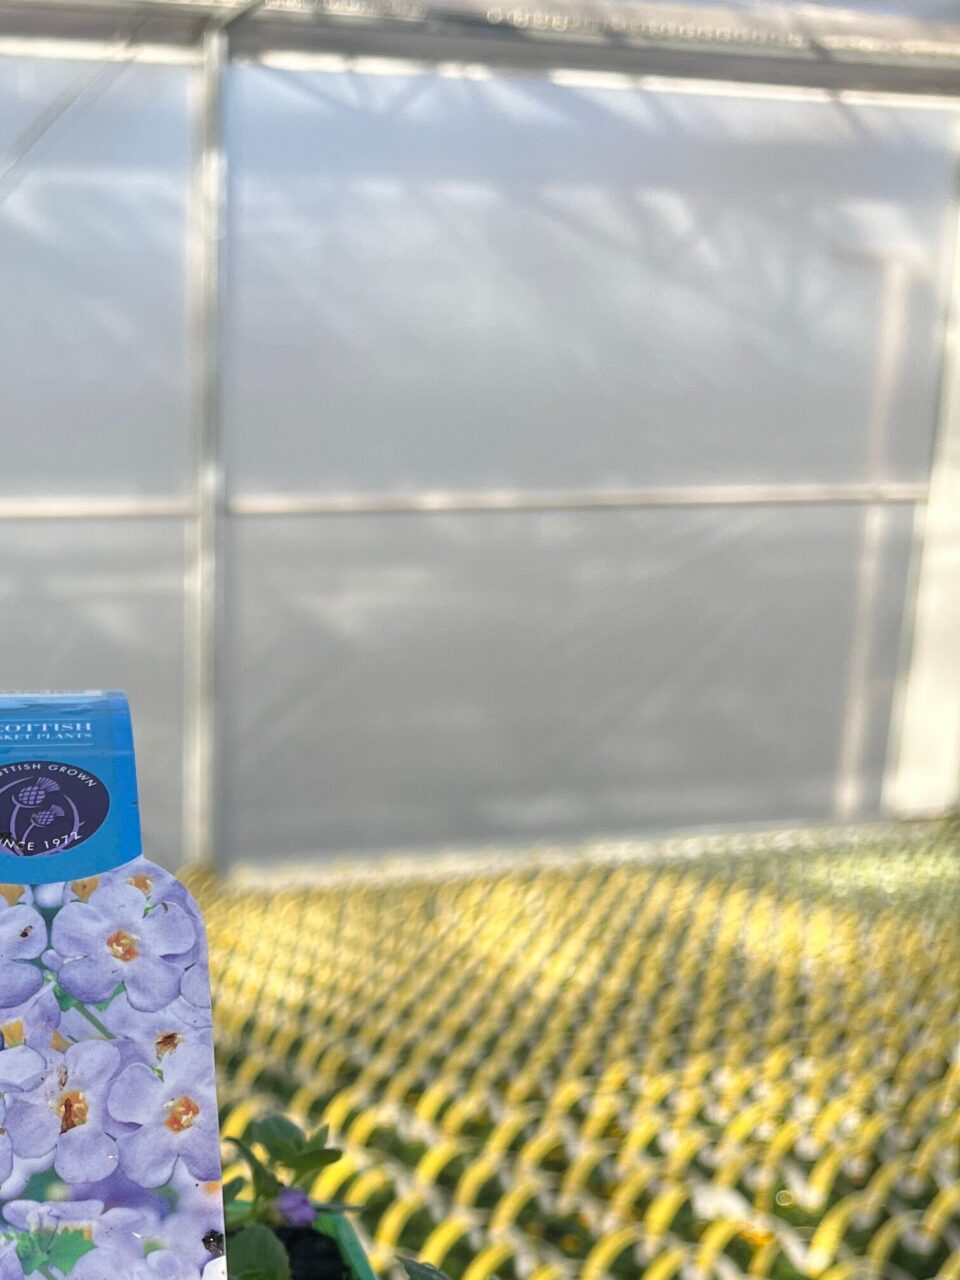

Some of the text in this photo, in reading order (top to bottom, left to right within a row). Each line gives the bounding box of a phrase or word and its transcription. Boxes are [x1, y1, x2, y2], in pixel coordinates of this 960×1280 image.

[37, 732, 93, 741] PLANTS
[48, 764, 97, 787] GROWN
[44, 831, 82, 850] 1972
